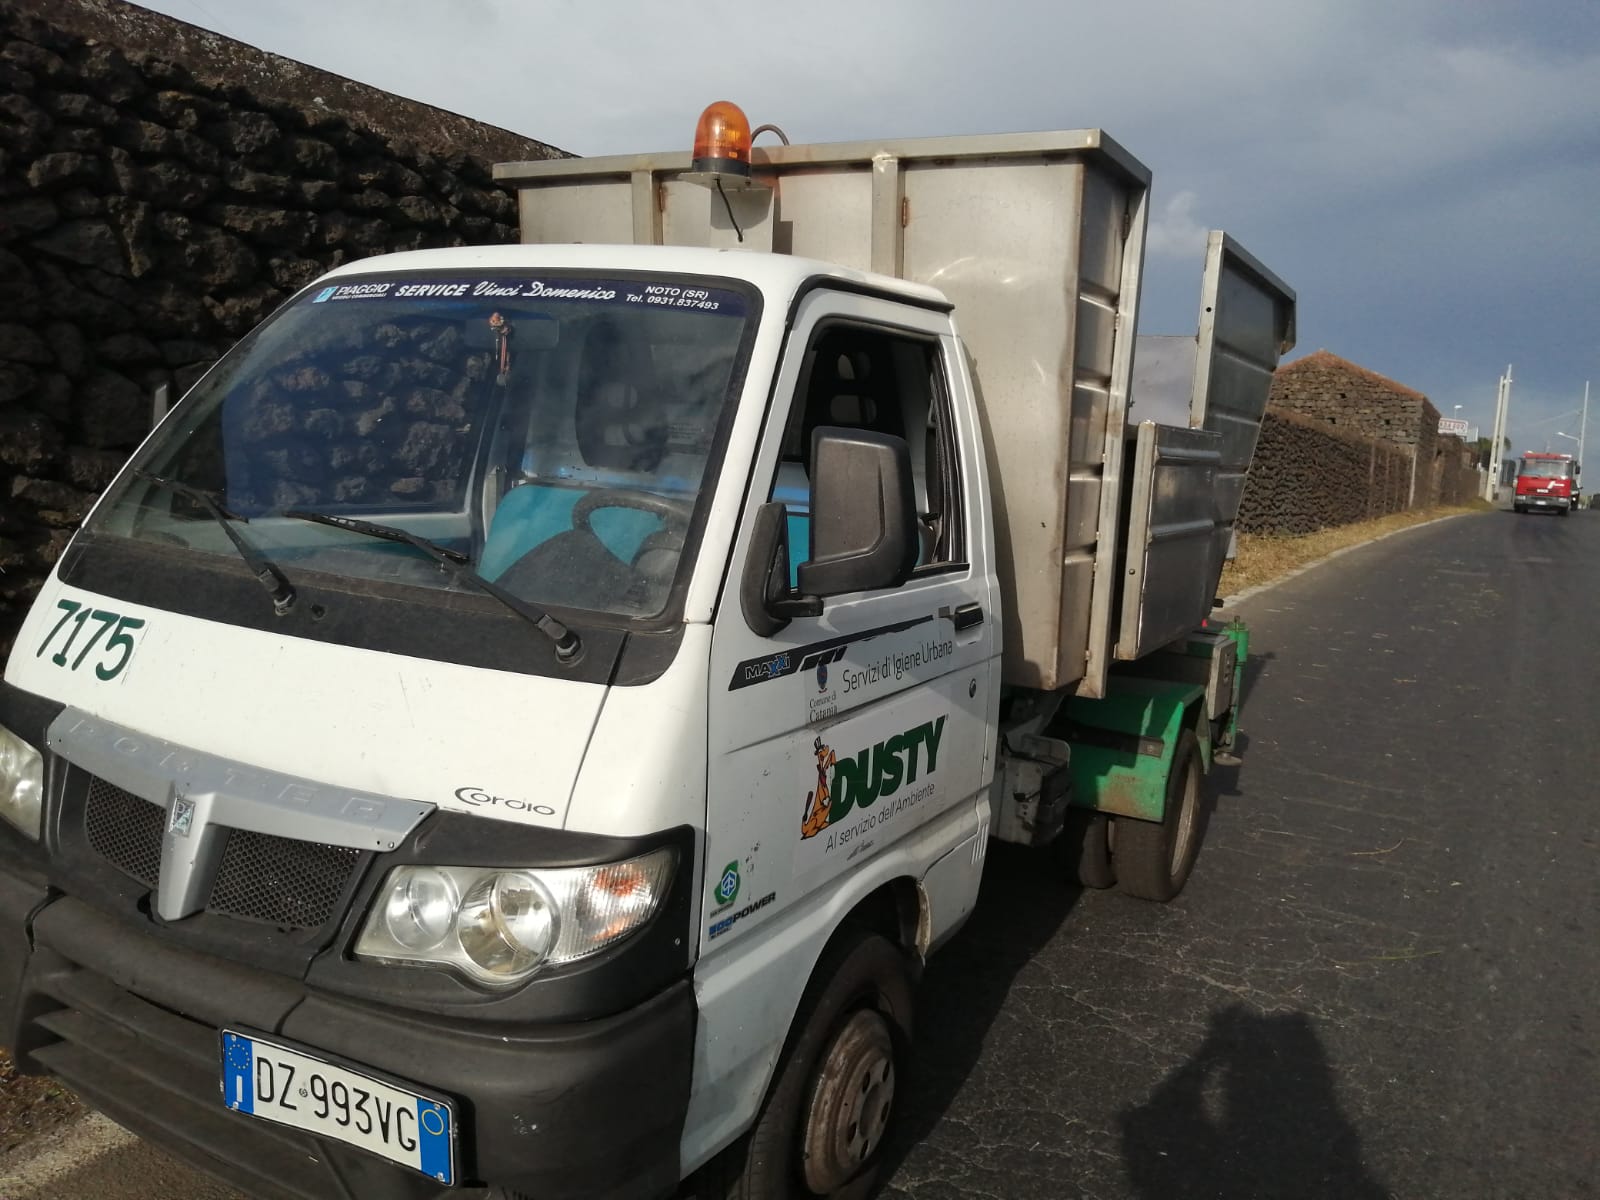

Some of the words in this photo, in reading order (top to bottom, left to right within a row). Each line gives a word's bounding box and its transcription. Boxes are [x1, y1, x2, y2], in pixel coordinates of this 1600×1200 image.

[335, 283, 391, 296] PIAGGIO
[395, 284, 470, 297] SERVICE
[473, 281, 523, 297] Vinci
[522, 281, 616, 300] Domenico
[645, 286, 680, 297] NOTO
[682, 289, 709, 301] (SR)
[626, 293, 643, 303] Tel.
[647, 295, 719, 310] 0931.837493
[36, 599, 145, 681] 7175
[842, 660, 881, 693] Servizi
[881, 655, 891, 679] di
[893, 652, 921, 681] Igiene
[922, 640, 953, 664] Urbana
[809, 694, 831, 709] Comune
[809, 702, 839, 722] Catania
[828, 715, 946, 825] DUSTY
[826, 831, 838, 853] Al
[839, 814, 877, 846] servizio
[878, 783, 935, 824] dell'Ambiente
